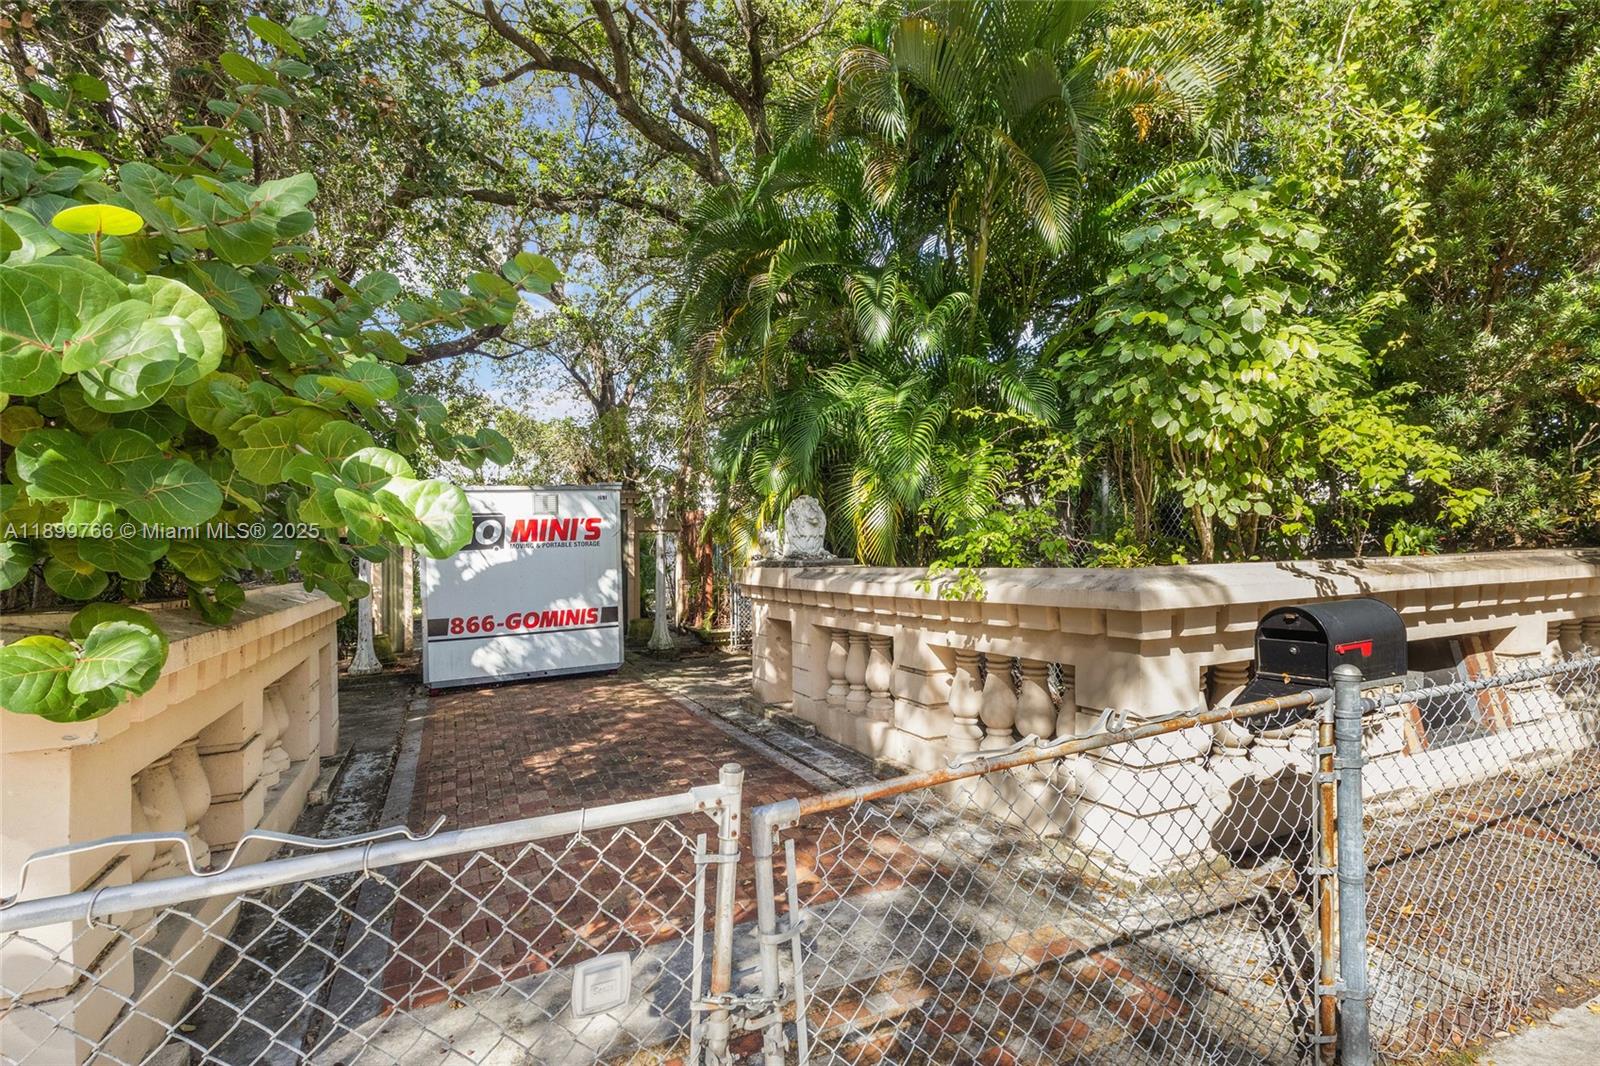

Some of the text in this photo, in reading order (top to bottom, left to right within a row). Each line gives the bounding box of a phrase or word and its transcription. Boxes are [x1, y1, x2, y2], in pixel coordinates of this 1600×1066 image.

[472, 518, 602, 545] O MINI'S
[450, 607, 599, 635] 866-GOMINIS
